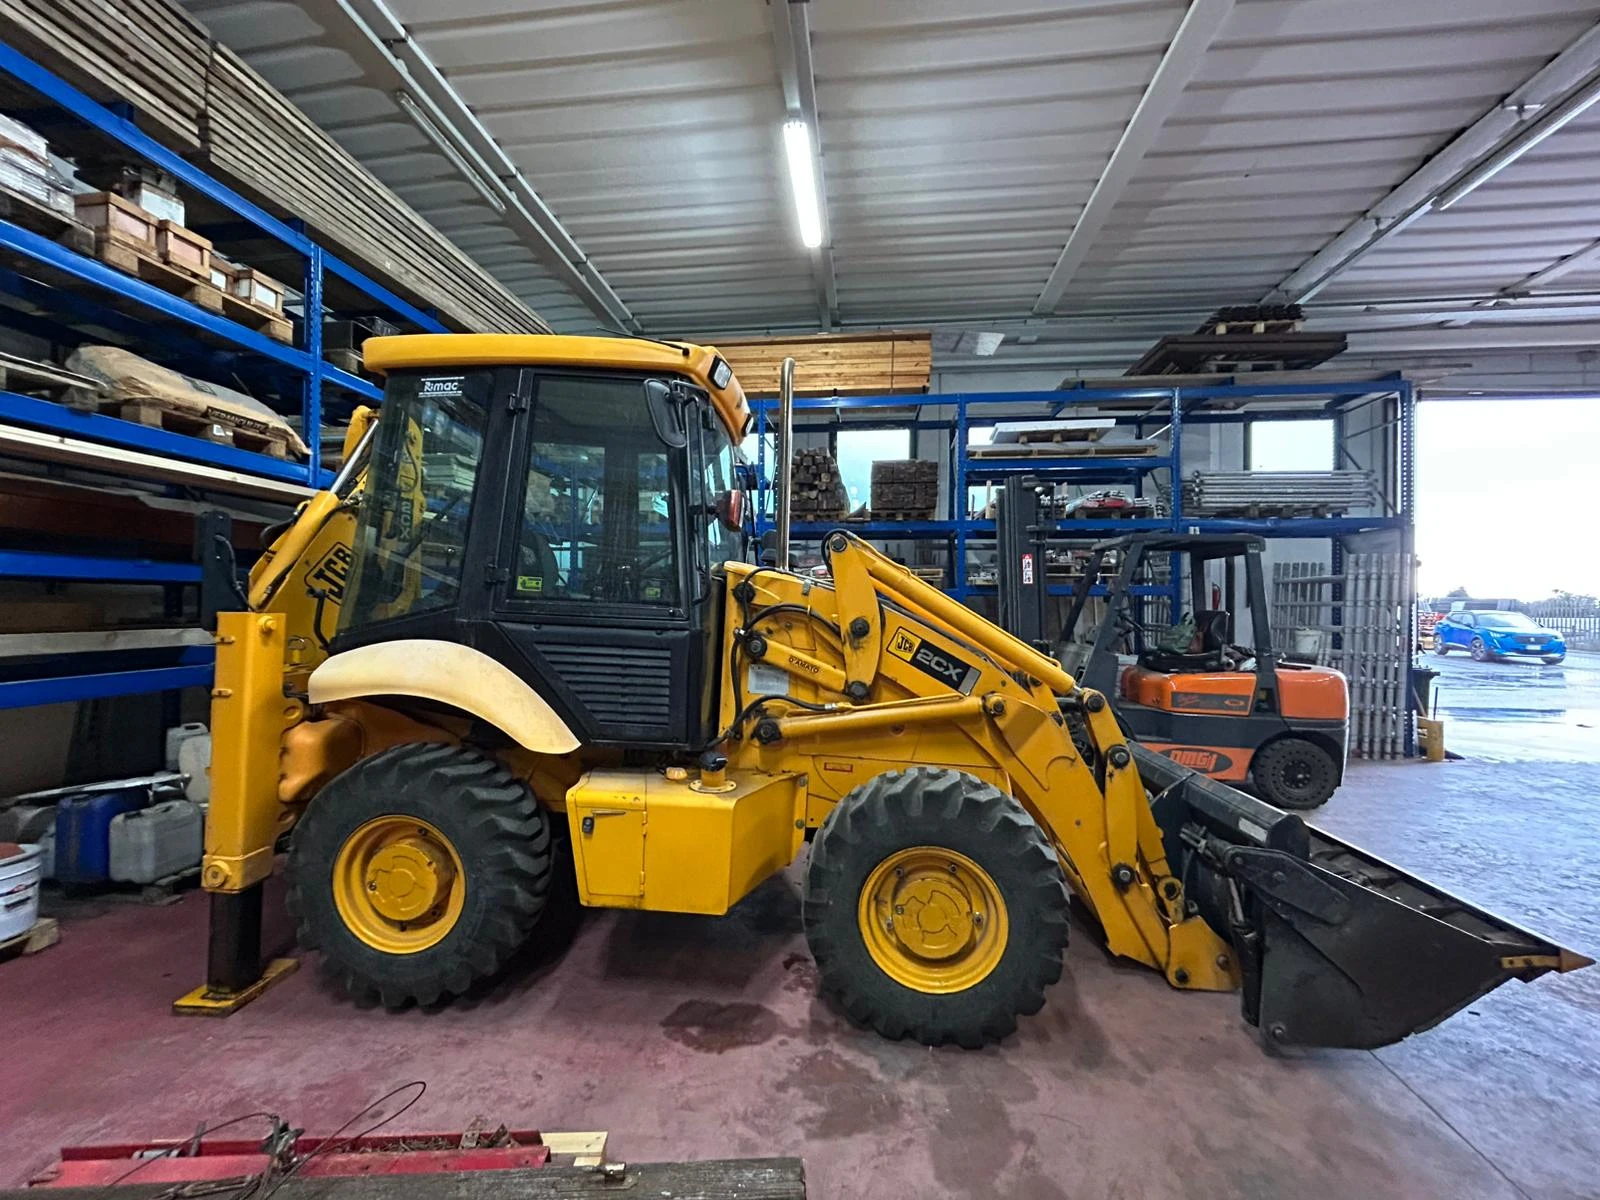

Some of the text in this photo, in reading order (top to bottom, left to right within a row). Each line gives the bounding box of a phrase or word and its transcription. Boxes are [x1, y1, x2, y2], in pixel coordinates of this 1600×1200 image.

[423, 381, 459, 392] Rimac
[312, 547, 352, 600] JCB
[897, 635, 915, 653] JCB
[915, 647, 964, 683] 2CX
